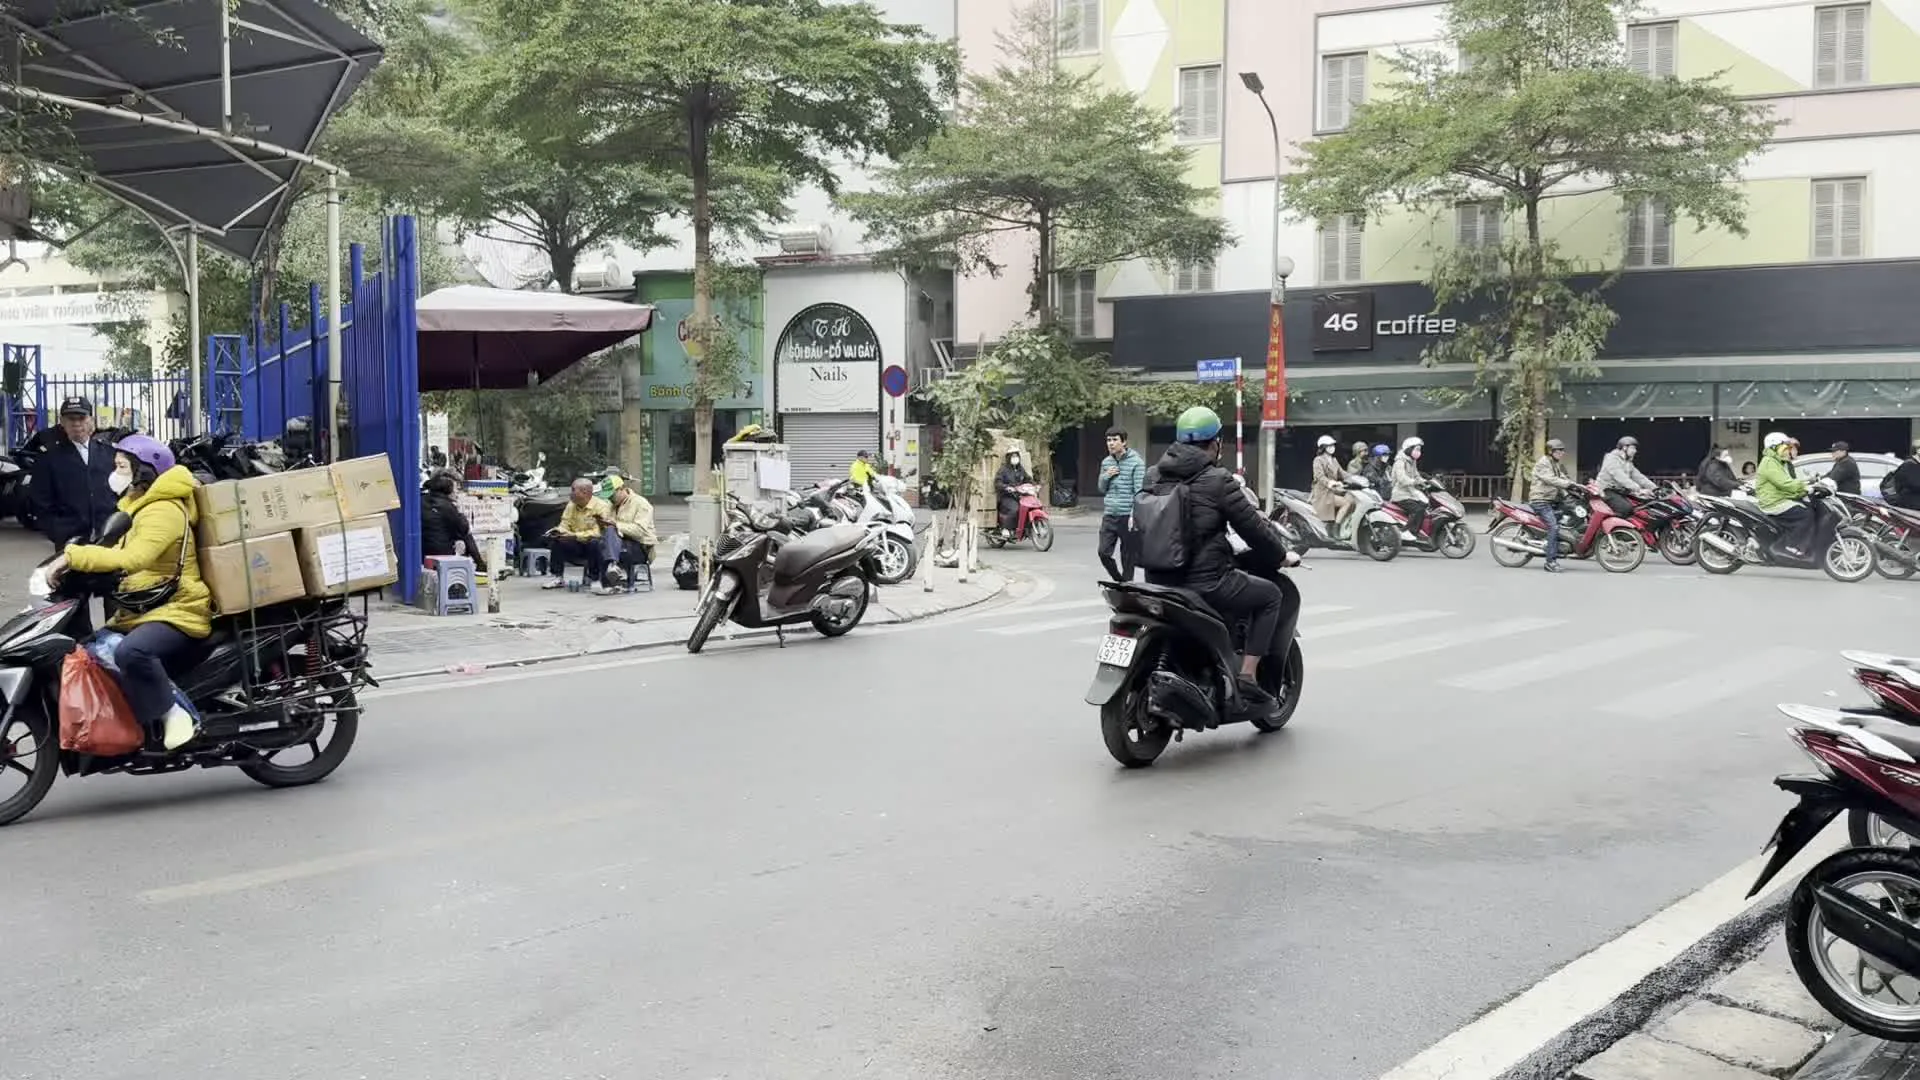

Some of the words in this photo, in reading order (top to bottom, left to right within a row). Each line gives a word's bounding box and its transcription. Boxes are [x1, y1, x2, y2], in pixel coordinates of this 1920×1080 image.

[1323, 313, 1358, 331] 46
[1376, 314, 1457, 335] coffee
[810, 365, 848, 382] Nails
[1727, 422, 1751, 433] 46
